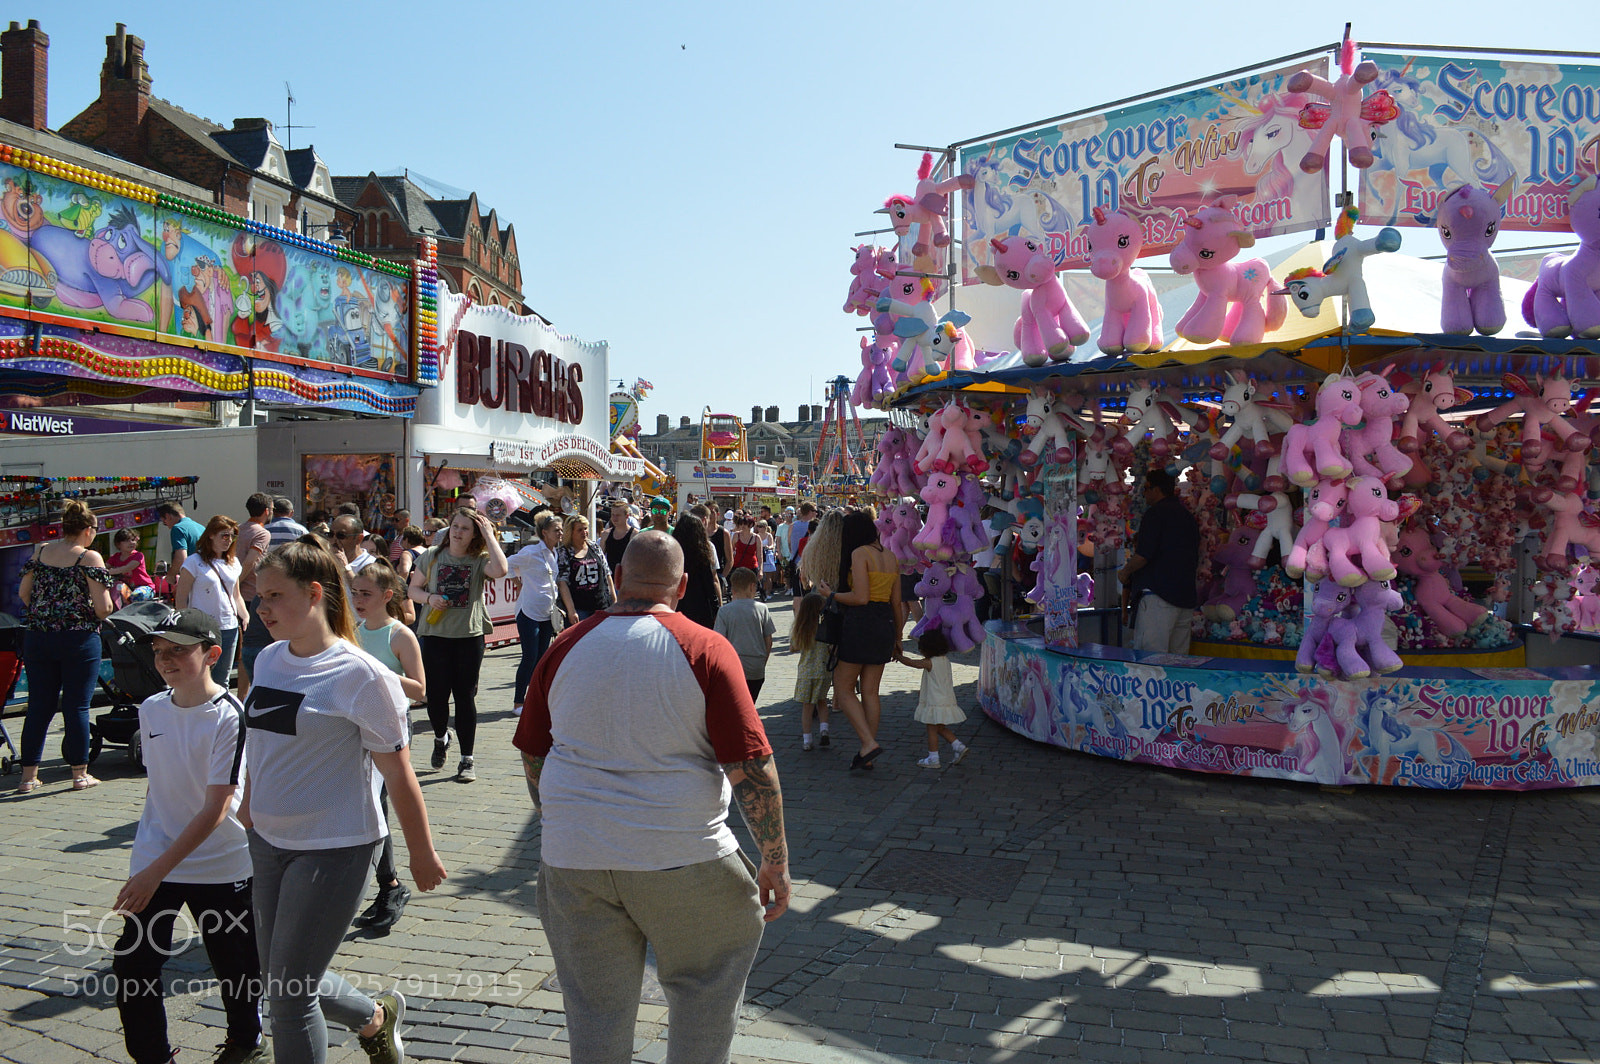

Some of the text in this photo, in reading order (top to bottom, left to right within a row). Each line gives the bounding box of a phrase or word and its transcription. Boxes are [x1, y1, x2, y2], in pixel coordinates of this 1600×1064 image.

[1432, 62, 1600, 125] Score ov
[1008, 114, 1188, 188] Score over
[1124, 157, 1166, 207] To
[1175, 124, 1243, 176] Win
[1524, 126, 1576, 186] 10
[1502, 192, 1568, 226] layer
[457, 329, 584, 426] BURGERS
[11, 412, 74, 435] NatWest
[541, 438, 569, 462] CLASS
[571, 438, 614, 468] DELICIOUS
[618, 459, 637, 471] FOOD
[575, 563, 599, 586] 45
[1086, 662, 1197, 703] Score over
[1413, 684, 1554, 720] Score over
[1139, 695, 1255, 739] 10 To Win
[1485, 718, 1520, 754] 10
[1520, 720, 1548, 757] To
[1088, 727, 1300, 773] Every Player Gets A Unicorn
[1398, 755, 1453, 785] Every
[1453, 756, 1513, 786] Player
[1513, 761, 1547, 784] Gets
[1545, 758, 1564, 783] A
